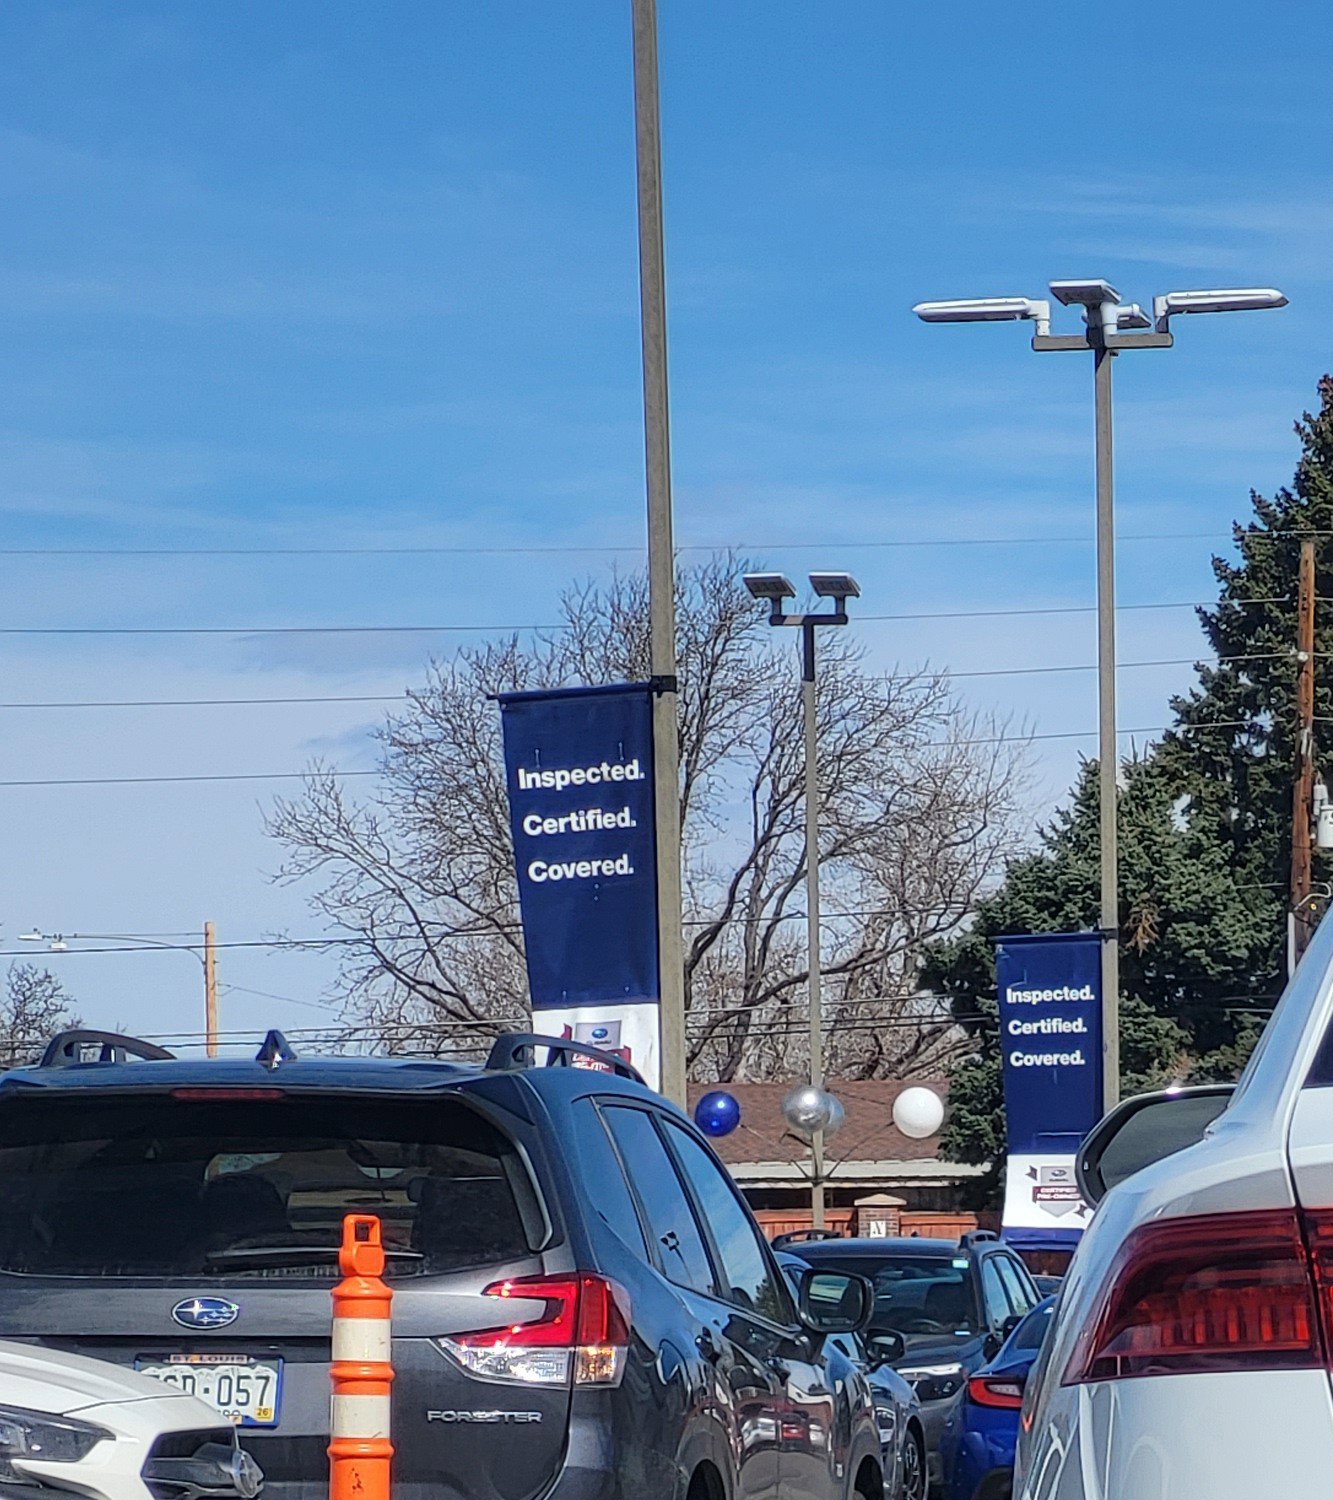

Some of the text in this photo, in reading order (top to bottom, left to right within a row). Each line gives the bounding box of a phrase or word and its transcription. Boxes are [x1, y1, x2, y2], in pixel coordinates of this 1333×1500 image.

[518, 759, 645, 791] Inspected.
[523, 806, 637, 836] Certified.
[528, 853, 635, 883] Covered.
[1006, 985, 1095, 1005] Inspected.
[1008, 1017, 1088, 1035] Certified.
[1010, 1049, 1086, 1067] Covered.
[427, 1410, 543, 1423] FORESTER
